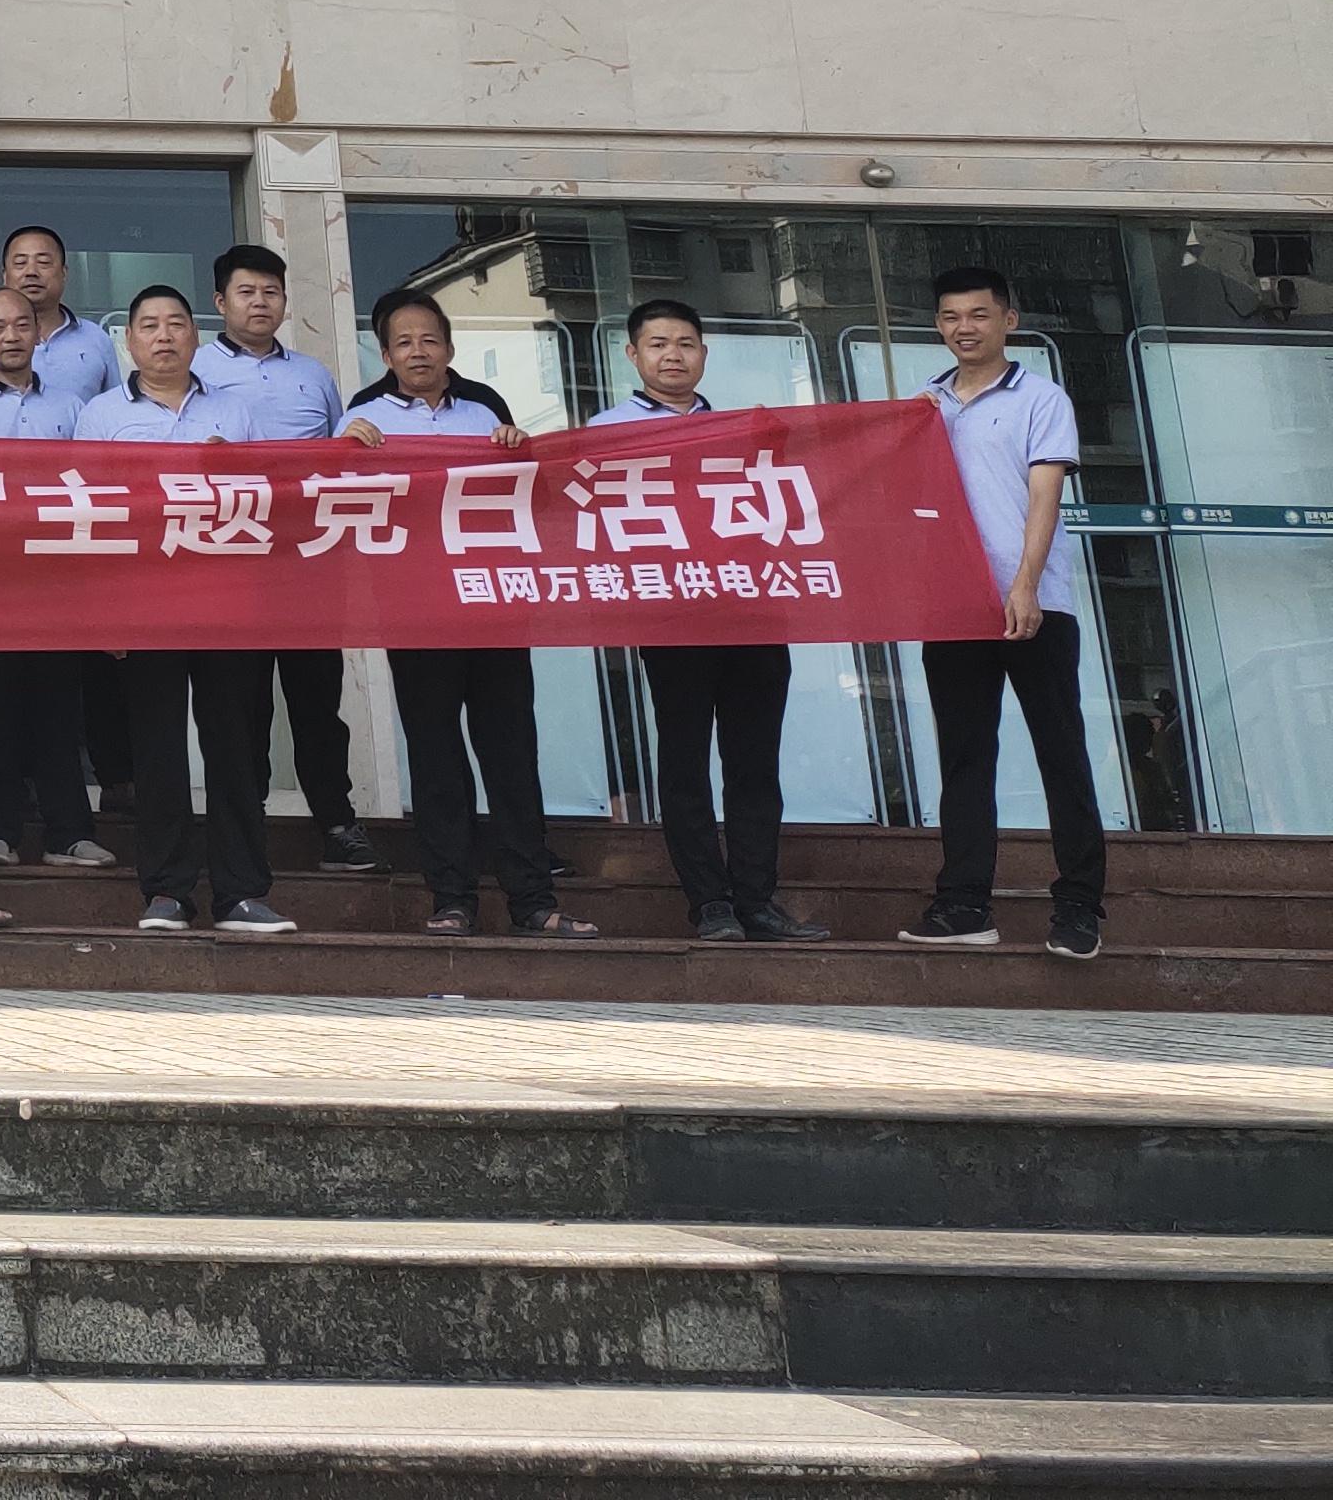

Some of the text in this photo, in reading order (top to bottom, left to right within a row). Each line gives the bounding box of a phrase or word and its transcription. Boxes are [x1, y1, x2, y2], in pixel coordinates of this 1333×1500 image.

[452, 559, 843, 604] 国网万载县供电公司
